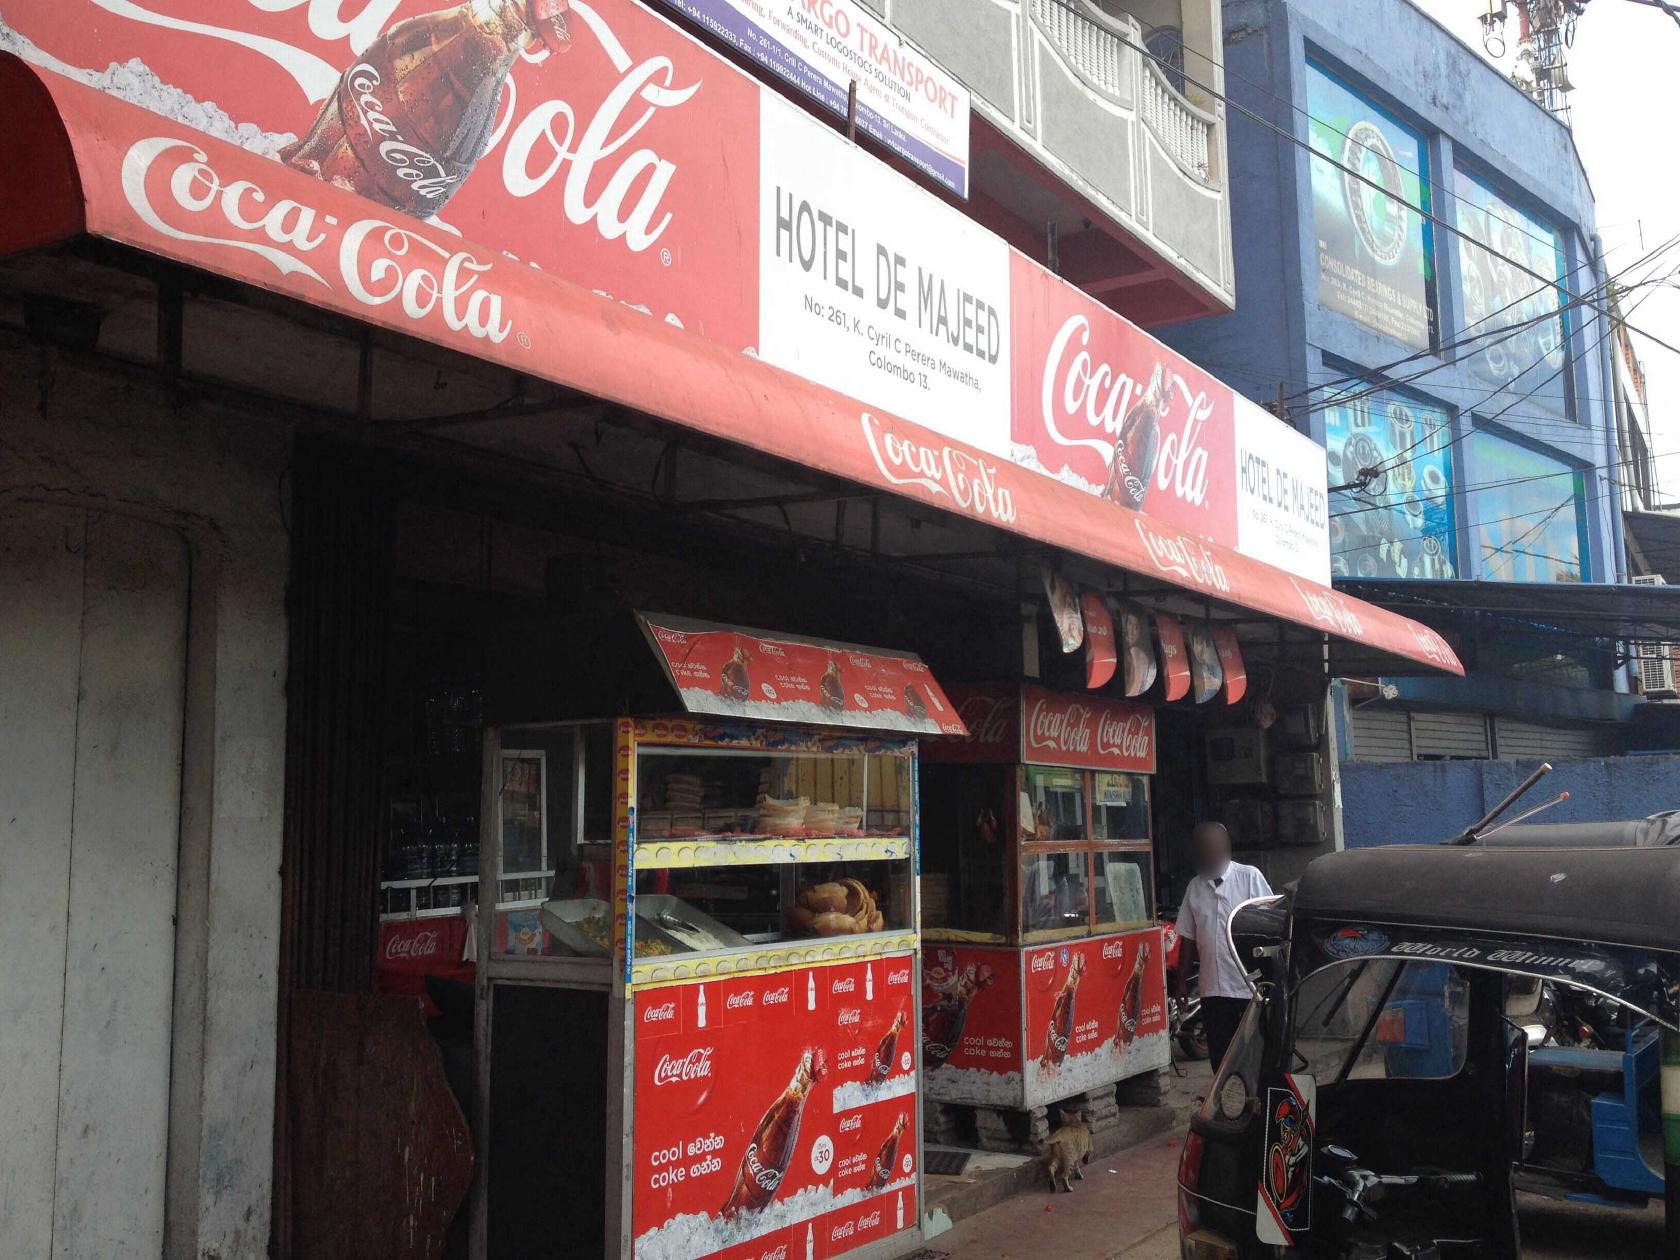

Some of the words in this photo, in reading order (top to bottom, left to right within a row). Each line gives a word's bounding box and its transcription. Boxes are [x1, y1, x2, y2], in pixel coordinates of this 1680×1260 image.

[687, 6, 701, 19] +94
[787, 5, 794, 20] A
[796, 11, 824, 40] SMART
[874, 69, 911, 103] SOLUTION
[857, 22, 958, 119] TRANSPORT
[348, 63, 457, 198] Coca-Cola
[120, 136, 514, 344] Coca-Cola
[776, 185, 864, 299] HOTEL
[876, 242, 907, 321] DE
[918, 266, 1000, 365] MAJEED
[804, 294, 825, 318] No:
[828, 305, 850, 333] 261,
[853, 317, 864, 337] K.
[867, 325, 891, 350] Cyril
[894, 337, 902, 354] C
[904, 343, 937, 371] Perera
[868, 350, 916, 384] Colombo
[918, 372, 931, 391] 13.
[861, 412, 1017, 523] Coca-Cola
[1240, 448, 1273, 504] HOTEL
[1276, 468, 1289, 512] DE
[1292, 476, 1325, 529] MAJEED
[1029, 699, 1090, 752] Coca-Cola
[1098, 710, 1149, 758] Coca-Cola
[386, 931, 439, 960] Coca-Cola
[654, 1047, 713, 1086] Coca-Cola
[650, 1166, 685, 1189] coke
[690, 1155, 722, 1177] ගන්න
[651, 1140, 683, 1165] cool
[687, 1132, 725, 1156] වෙන්න
